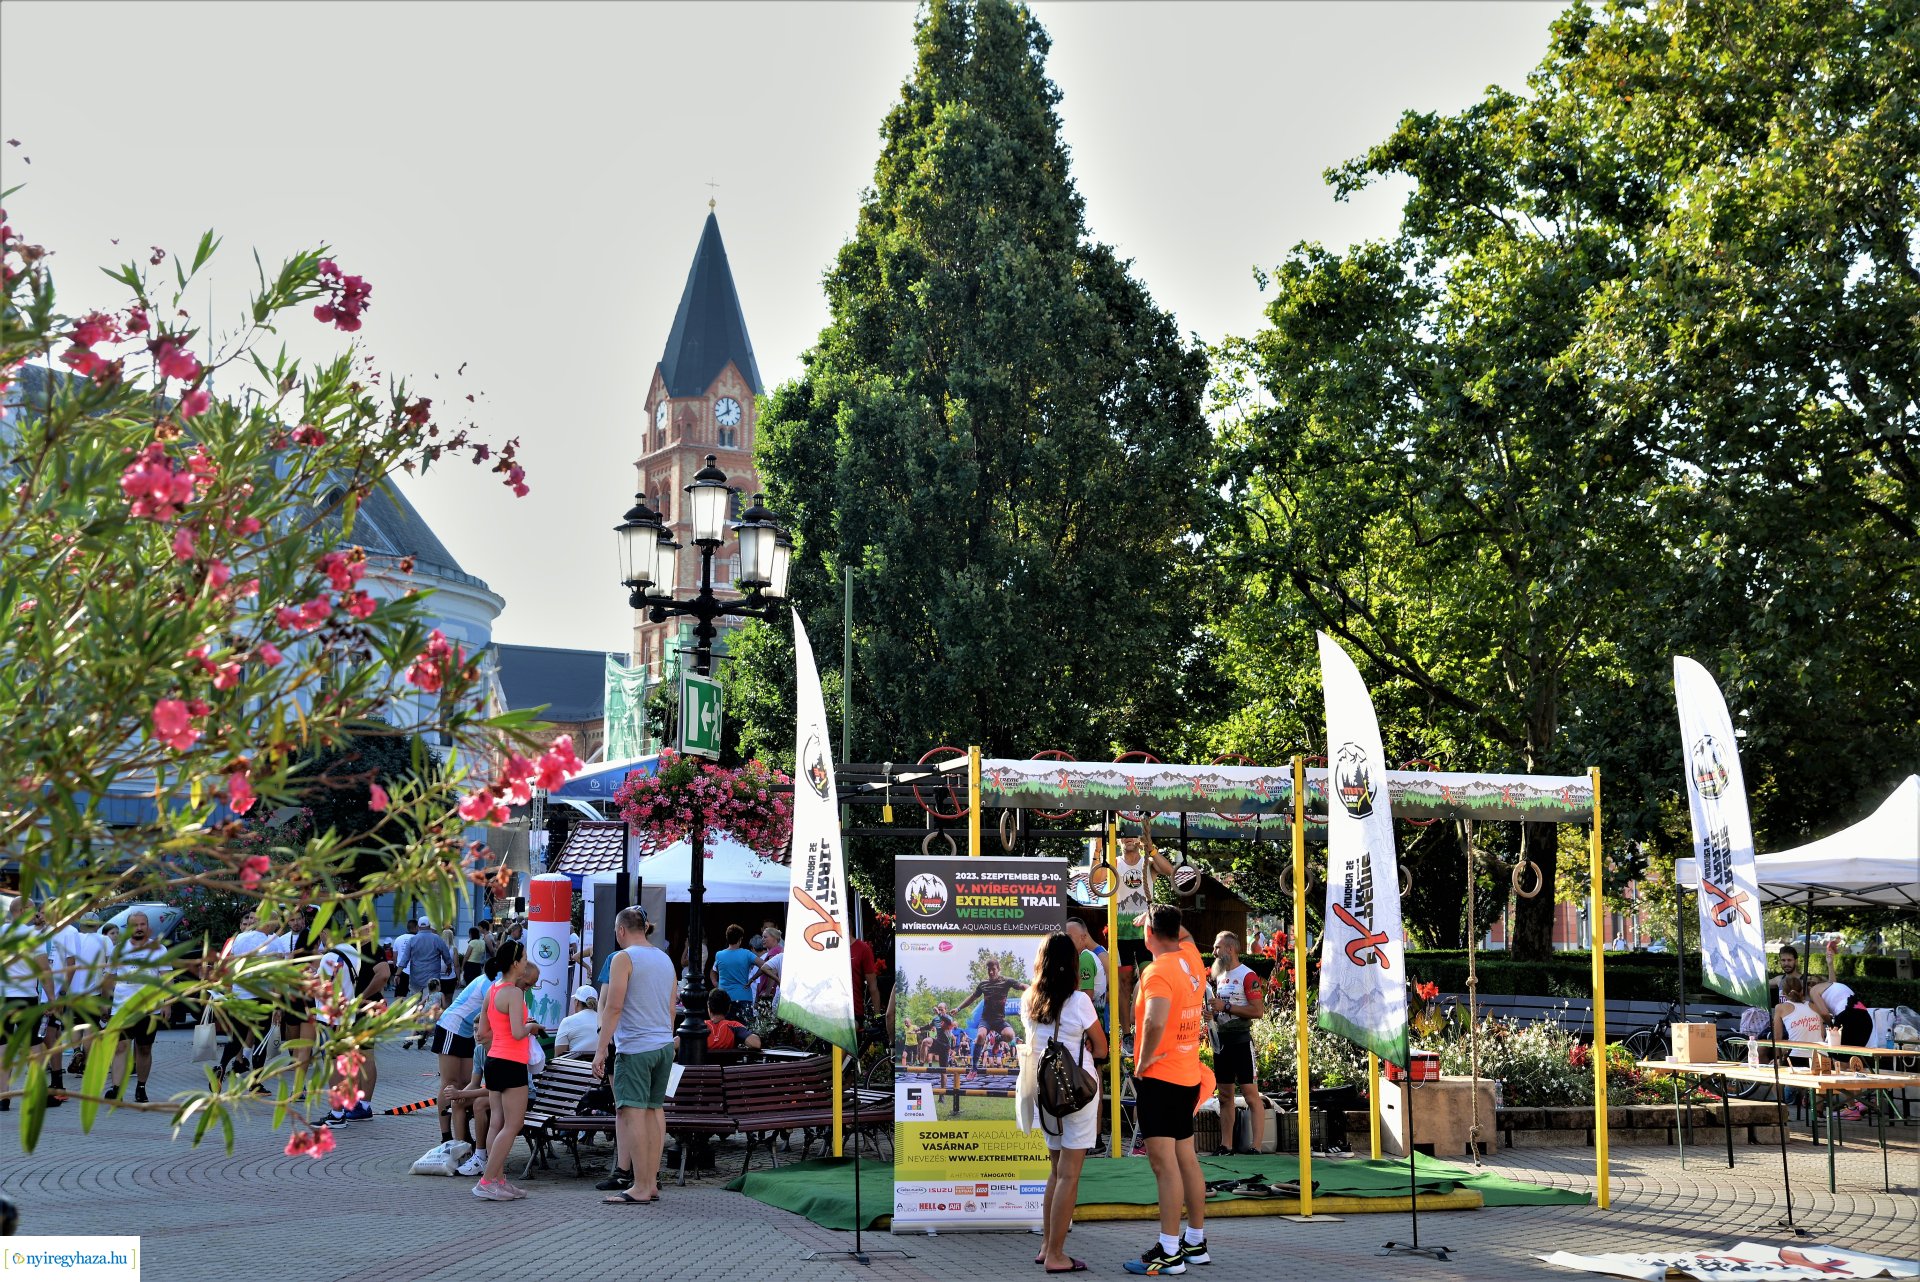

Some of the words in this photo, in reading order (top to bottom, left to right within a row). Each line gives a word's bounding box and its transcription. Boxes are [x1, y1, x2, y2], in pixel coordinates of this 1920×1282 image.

[955, 872, 979, 880] 2023.
[980, 872, 1040, 881] SZEPTEMBER
[1041, 873, 1062, 881] 9-10.
[955, 883, 969, 894] V.
[971, 881, 1057, 894] NYÍREGYHÁZI
[955, 895, 1018, 906] EXTREME
[1021, 896, 1060, 907] TRAIL
[955, 908, 1025, 919] WEEKEND
[962, 923, 1002, 931] AQUARIUS
[919, 1131, 969, 1140] SZOMBAT
[922, 1141, 980, 1151] VASÁRNAP
[982, 1141, 1043, 1151] TEREPFUTÁS
[907, 1154, 947, 1163] NEVEZÉS:
[948, 1154, 1051, 1162] WWW.EXTREMETRAIL.H
